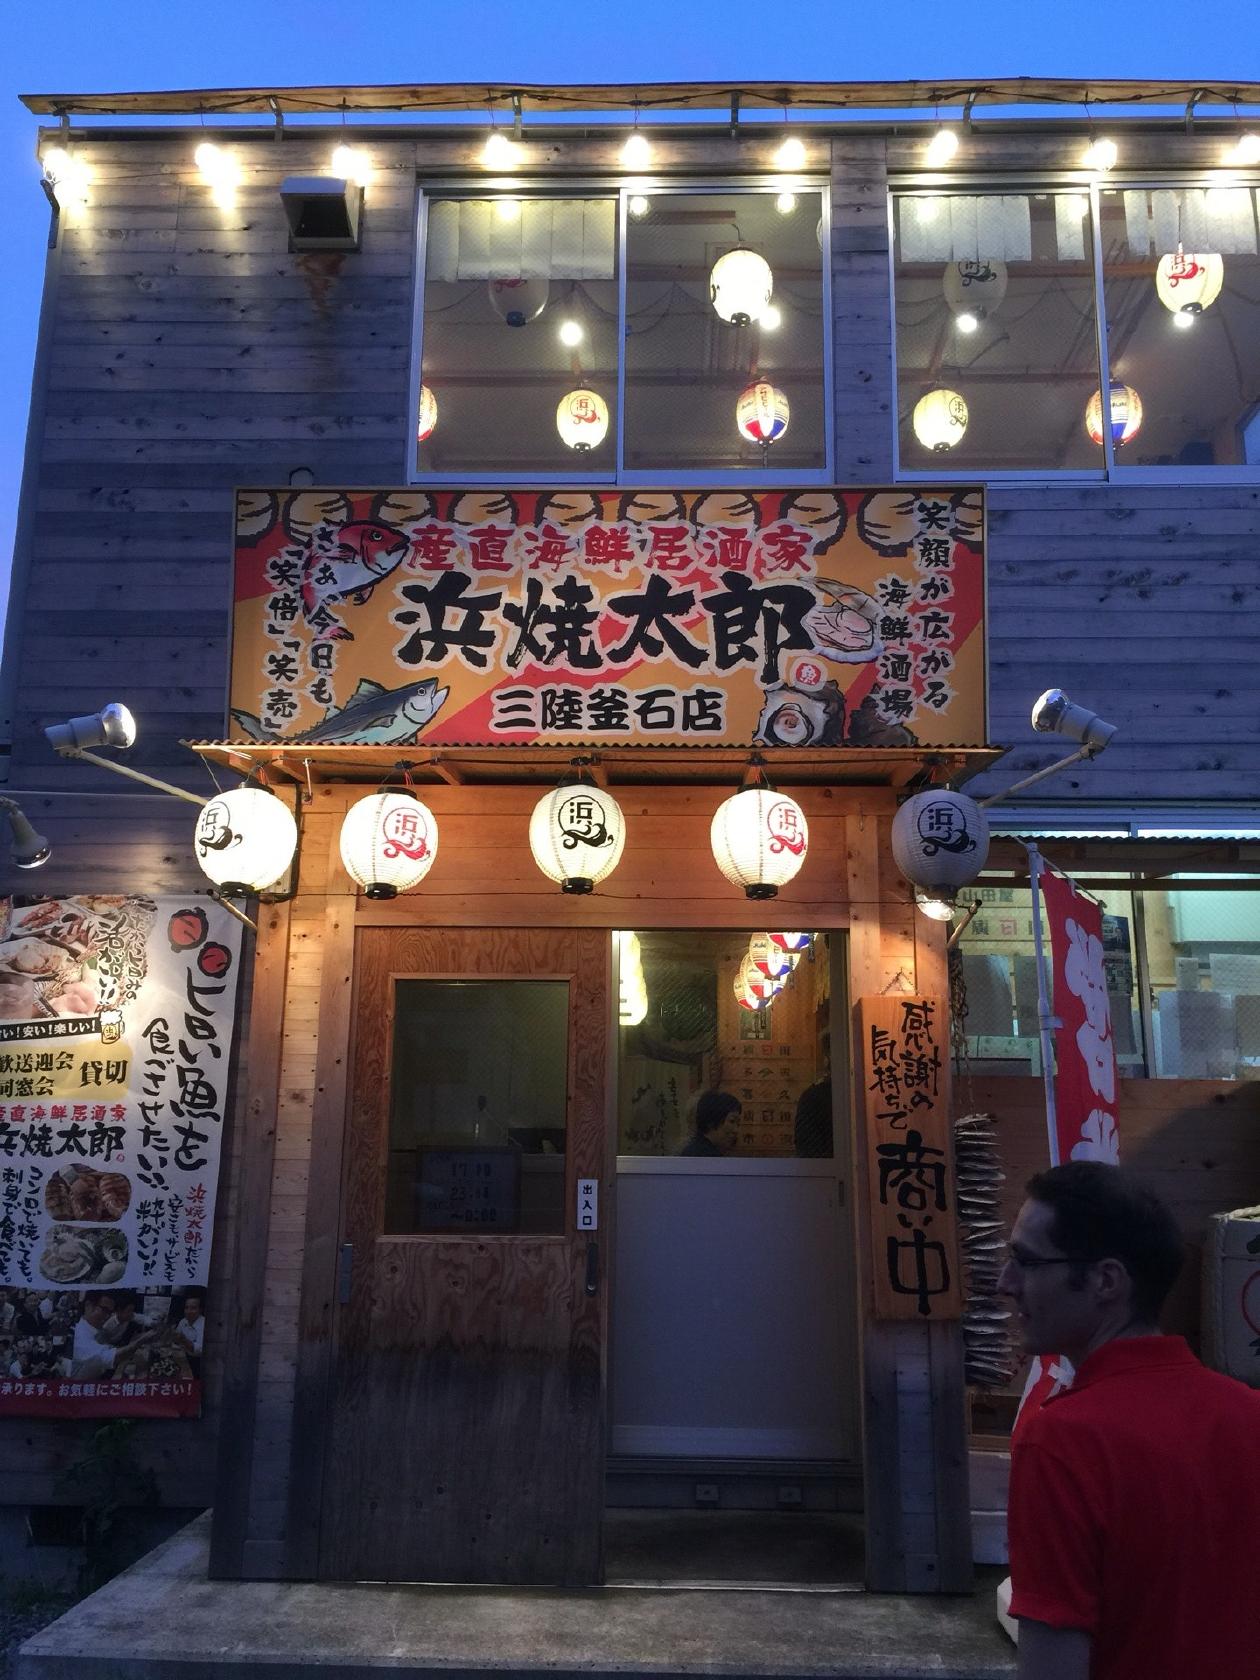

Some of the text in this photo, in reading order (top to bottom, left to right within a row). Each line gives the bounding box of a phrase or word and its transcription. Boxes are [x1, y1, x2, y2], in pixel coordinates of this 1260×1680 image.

[409, 524, 813, 573] 産直海鮮居酒家
[263, 549, 302, 729] 「笑倍」「笑売」
[395, 570, 816, 684] 浜焼太郎
[879, 577, 913, 719] 海鮮酒場
[917, 502, 951, 707] 笑顔が広がる
[495, 688, 724, 731] 三陸釜石店
[0, 1020, 96, 1040] い!安い!楽しい!
[79, 1060, 128, 1087] 貸切
[869, 1025, 915, 1130] 気持ちで
[900, 1000, 942, 1109] 感謝の
[582, 1184, 593, 1226] 出入口
[876, 1130, 951, 1316] 商い中
